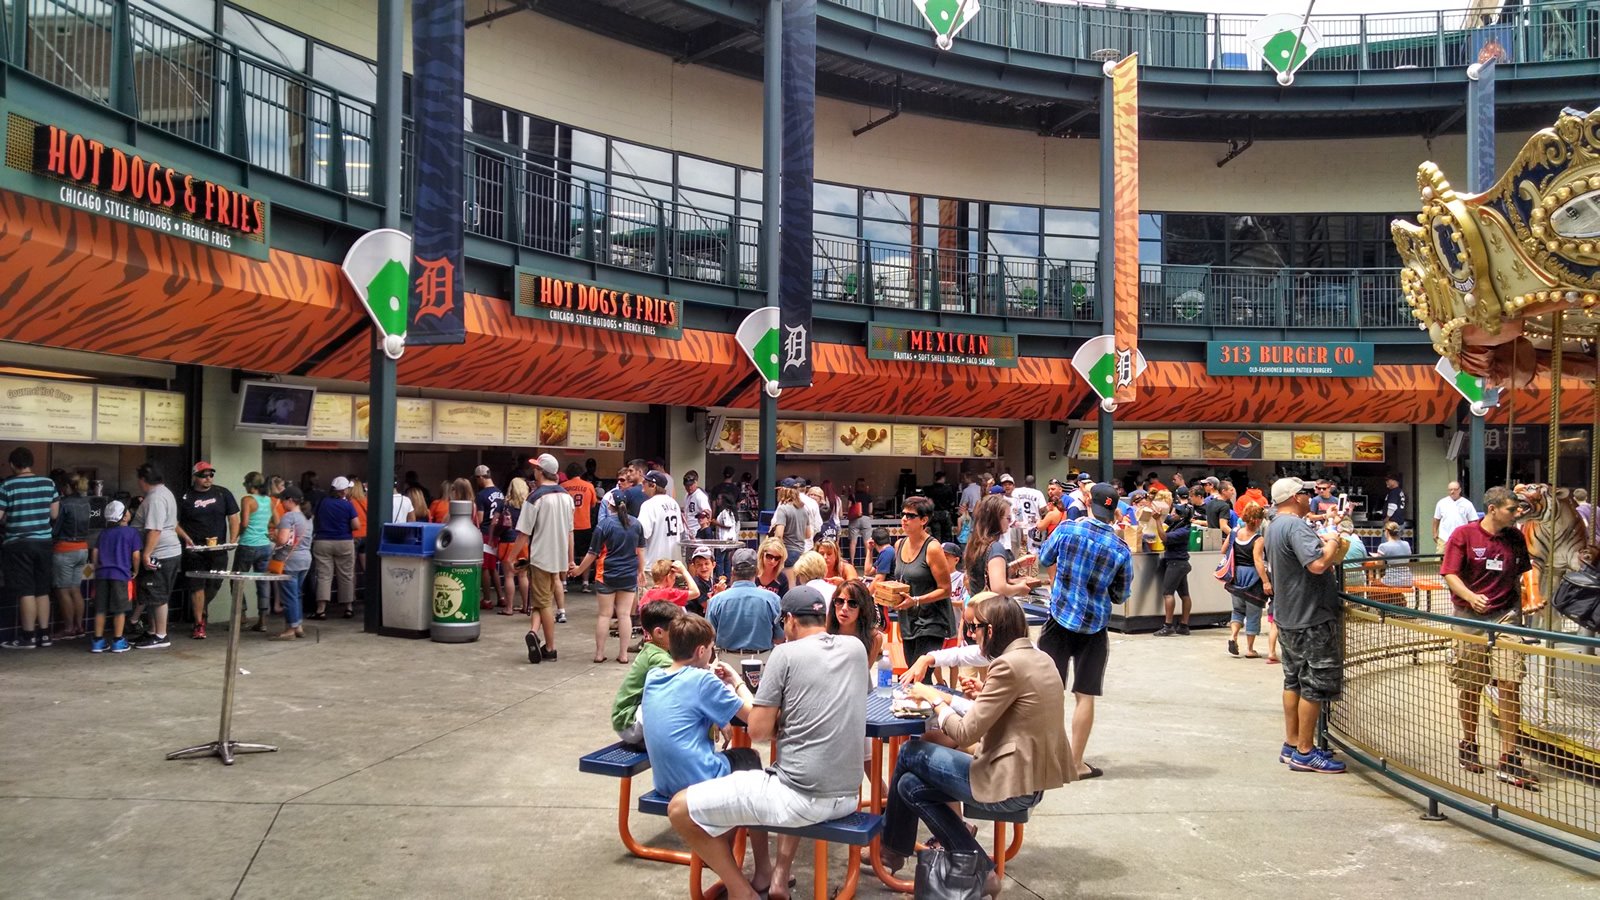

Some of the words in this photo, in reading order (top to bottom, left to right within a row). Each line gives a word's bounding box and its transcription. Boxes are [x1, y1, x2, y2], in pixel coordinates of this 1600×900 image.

[48, 125, 105, 186] HOT
[111, 147, 176, 208] DOGS
[183, 174, 197, 214] &
[204, 180, 263, 235] FRIES
[60, 186, 102, 212] CHICAGO
[104, 199, 130, 220] STYLE
[133, 207, 172, 232] HOTDOGS
[182, 222, 209, 243] FRENCH
[211, 231, 232, 249] FRIES
[414, 255, 455, 325] D
[540, 276, 574, 309] HOT
[577, 283, 618, 317] DOGS
[621, 292, 632, 319] &
[636, 294, 676, 326] FRIES
[549, 309, 575, 323] CHICAGO
[575, 315, 592, 325] STYLE
[592, 317, 618, 330] HOTDOGS
[623, 321, 641, 333] FRENCH
[642, 325, 656, 335] FRIES
[783, 323, 807, 373] D
[911, 330, 989, 355] MEXICAN
[1220, 345, 1251, 364] 313
[1260, 346, 1328, 364] BURGER
[1334, 346, 1362, 365] CO.
[893, 351, 913, 360] FAJITAS
[918, 353, 930, 361] SOFT
[931, 354, 946, 363] SHELL
[946, 355, 961, 364] TACOS
[966, 357, 978, 365] TACO
[978, 358, 996, 366] SALADS
[89, 508, 101, 519] psi
[1023, 501, 1031, 514] 9
[665, 515, 677, 537] 13
